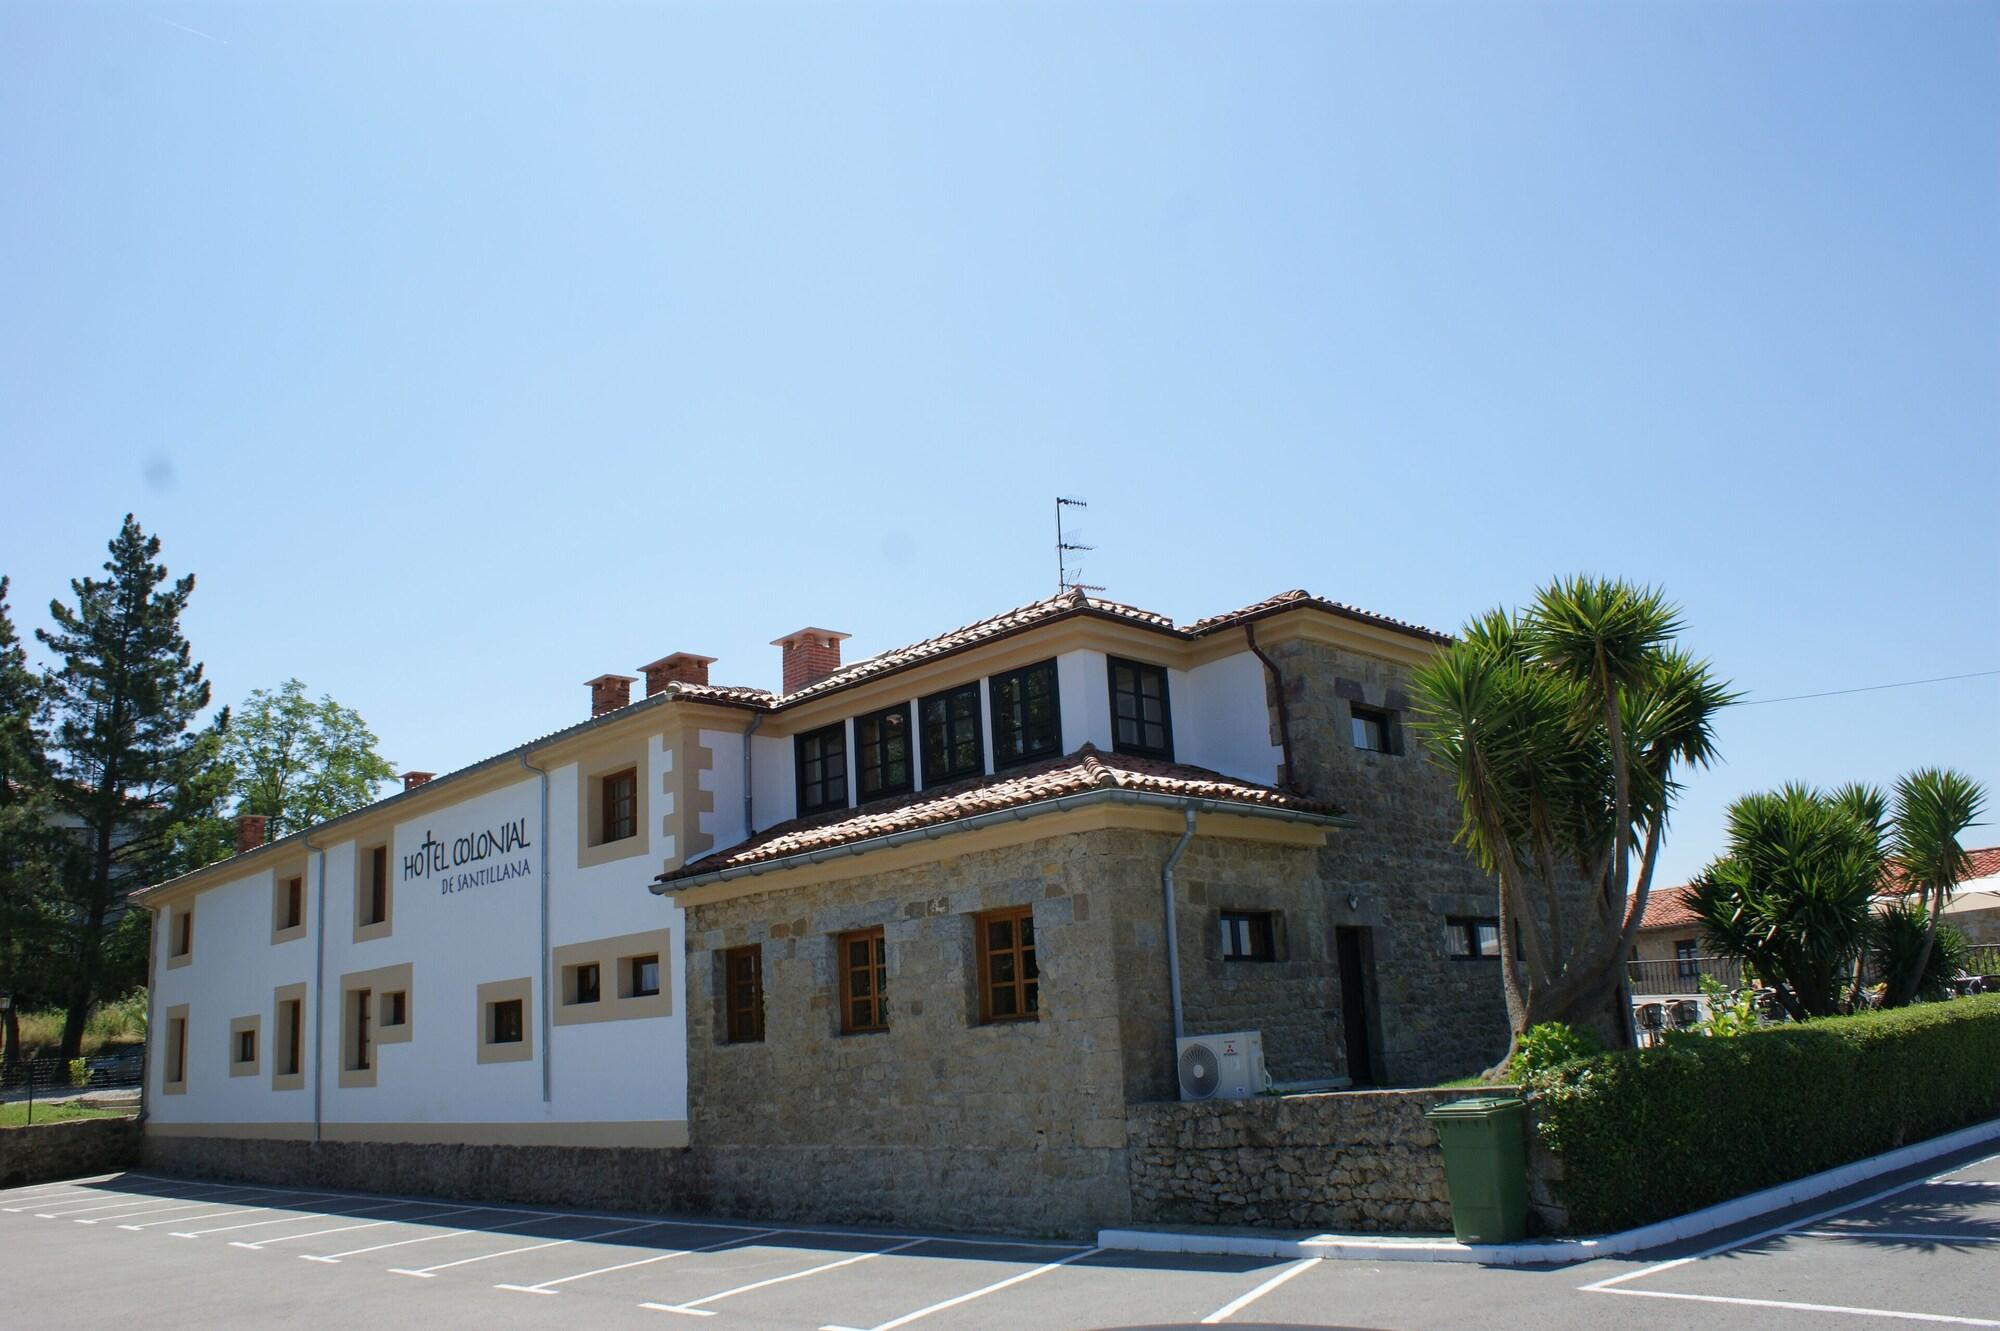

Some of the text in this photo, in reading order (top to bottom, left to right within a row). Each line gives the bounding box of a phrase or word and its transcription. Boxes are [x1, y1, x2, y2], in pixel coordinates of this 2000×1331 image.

[404, 817, 531, 881] HOTEL COLONIAL
[441, 858, 531, 895] DE SANTILLANA
